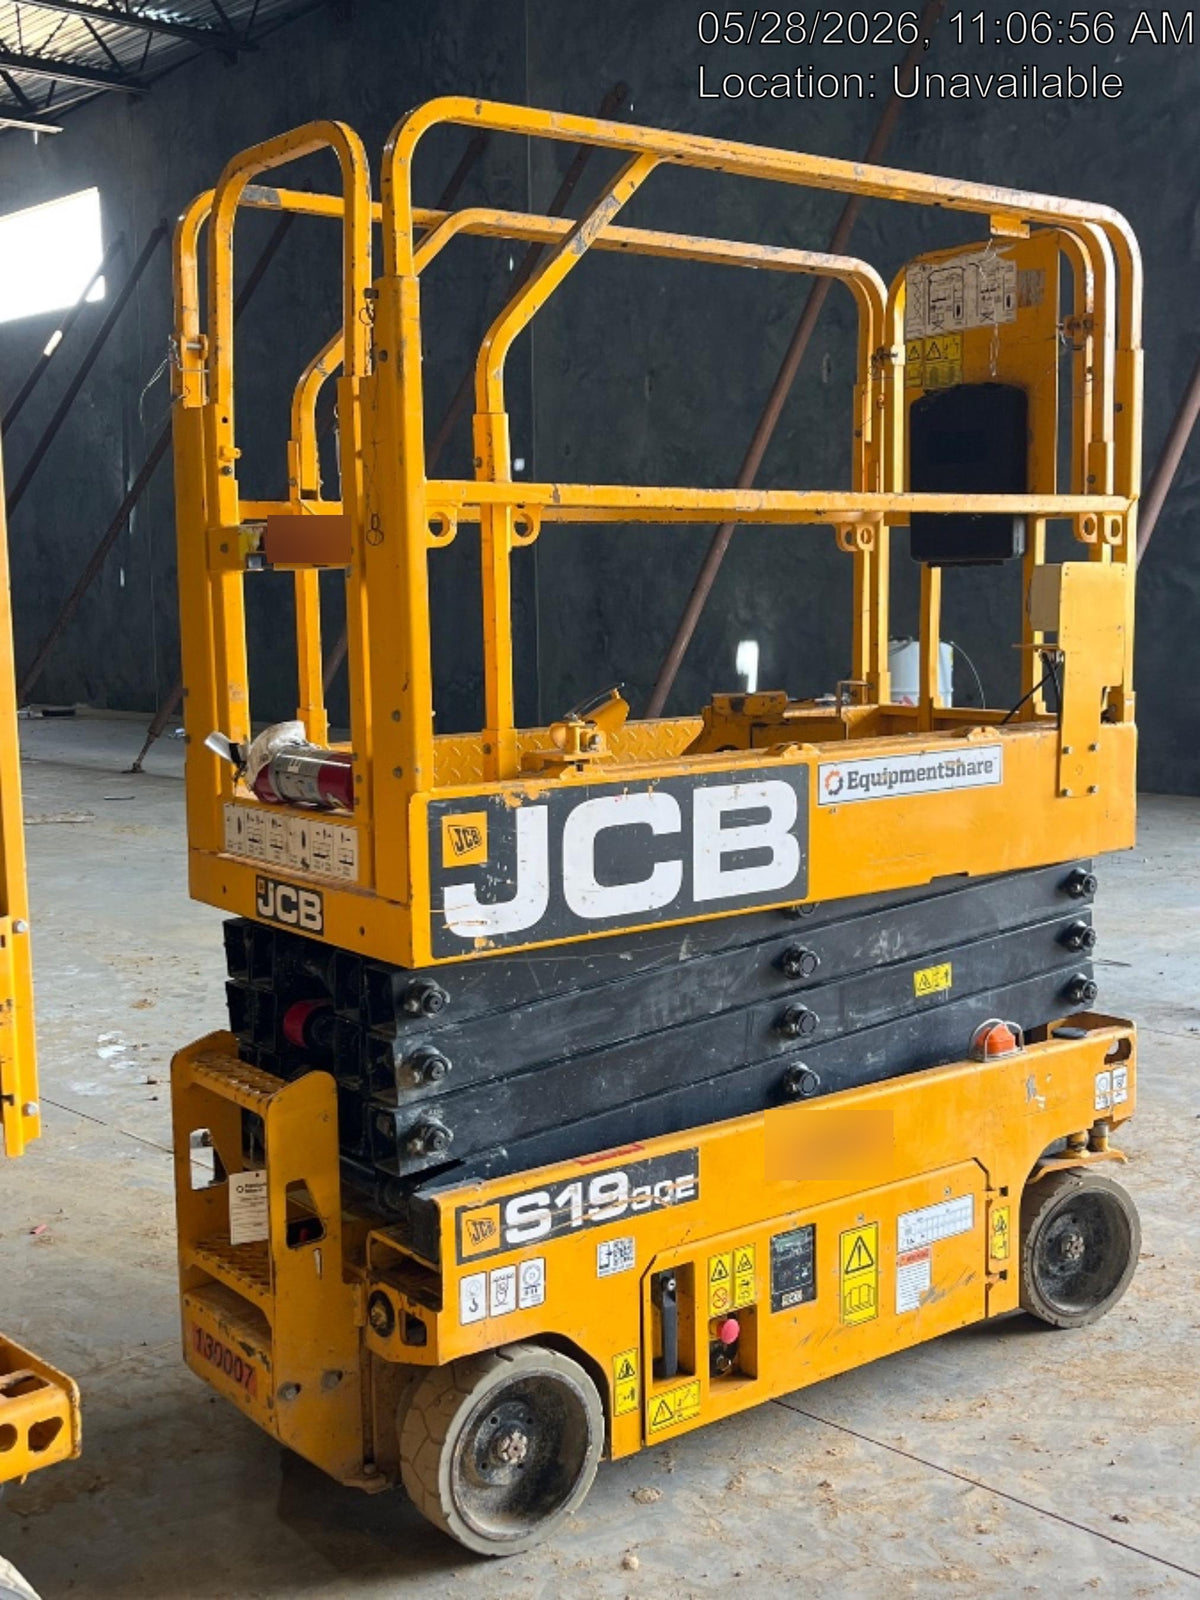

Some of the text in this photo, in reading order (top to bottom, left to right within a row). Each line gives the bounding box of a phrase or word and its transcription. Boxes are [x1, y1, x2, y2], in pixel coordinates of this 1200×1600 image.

[846, 759, 993, 792] EquipmentShare
[443, 779, 801, 937] JCB
[451, 826, 481, 854] JCB
[257, 880, 323, 931] JCB
